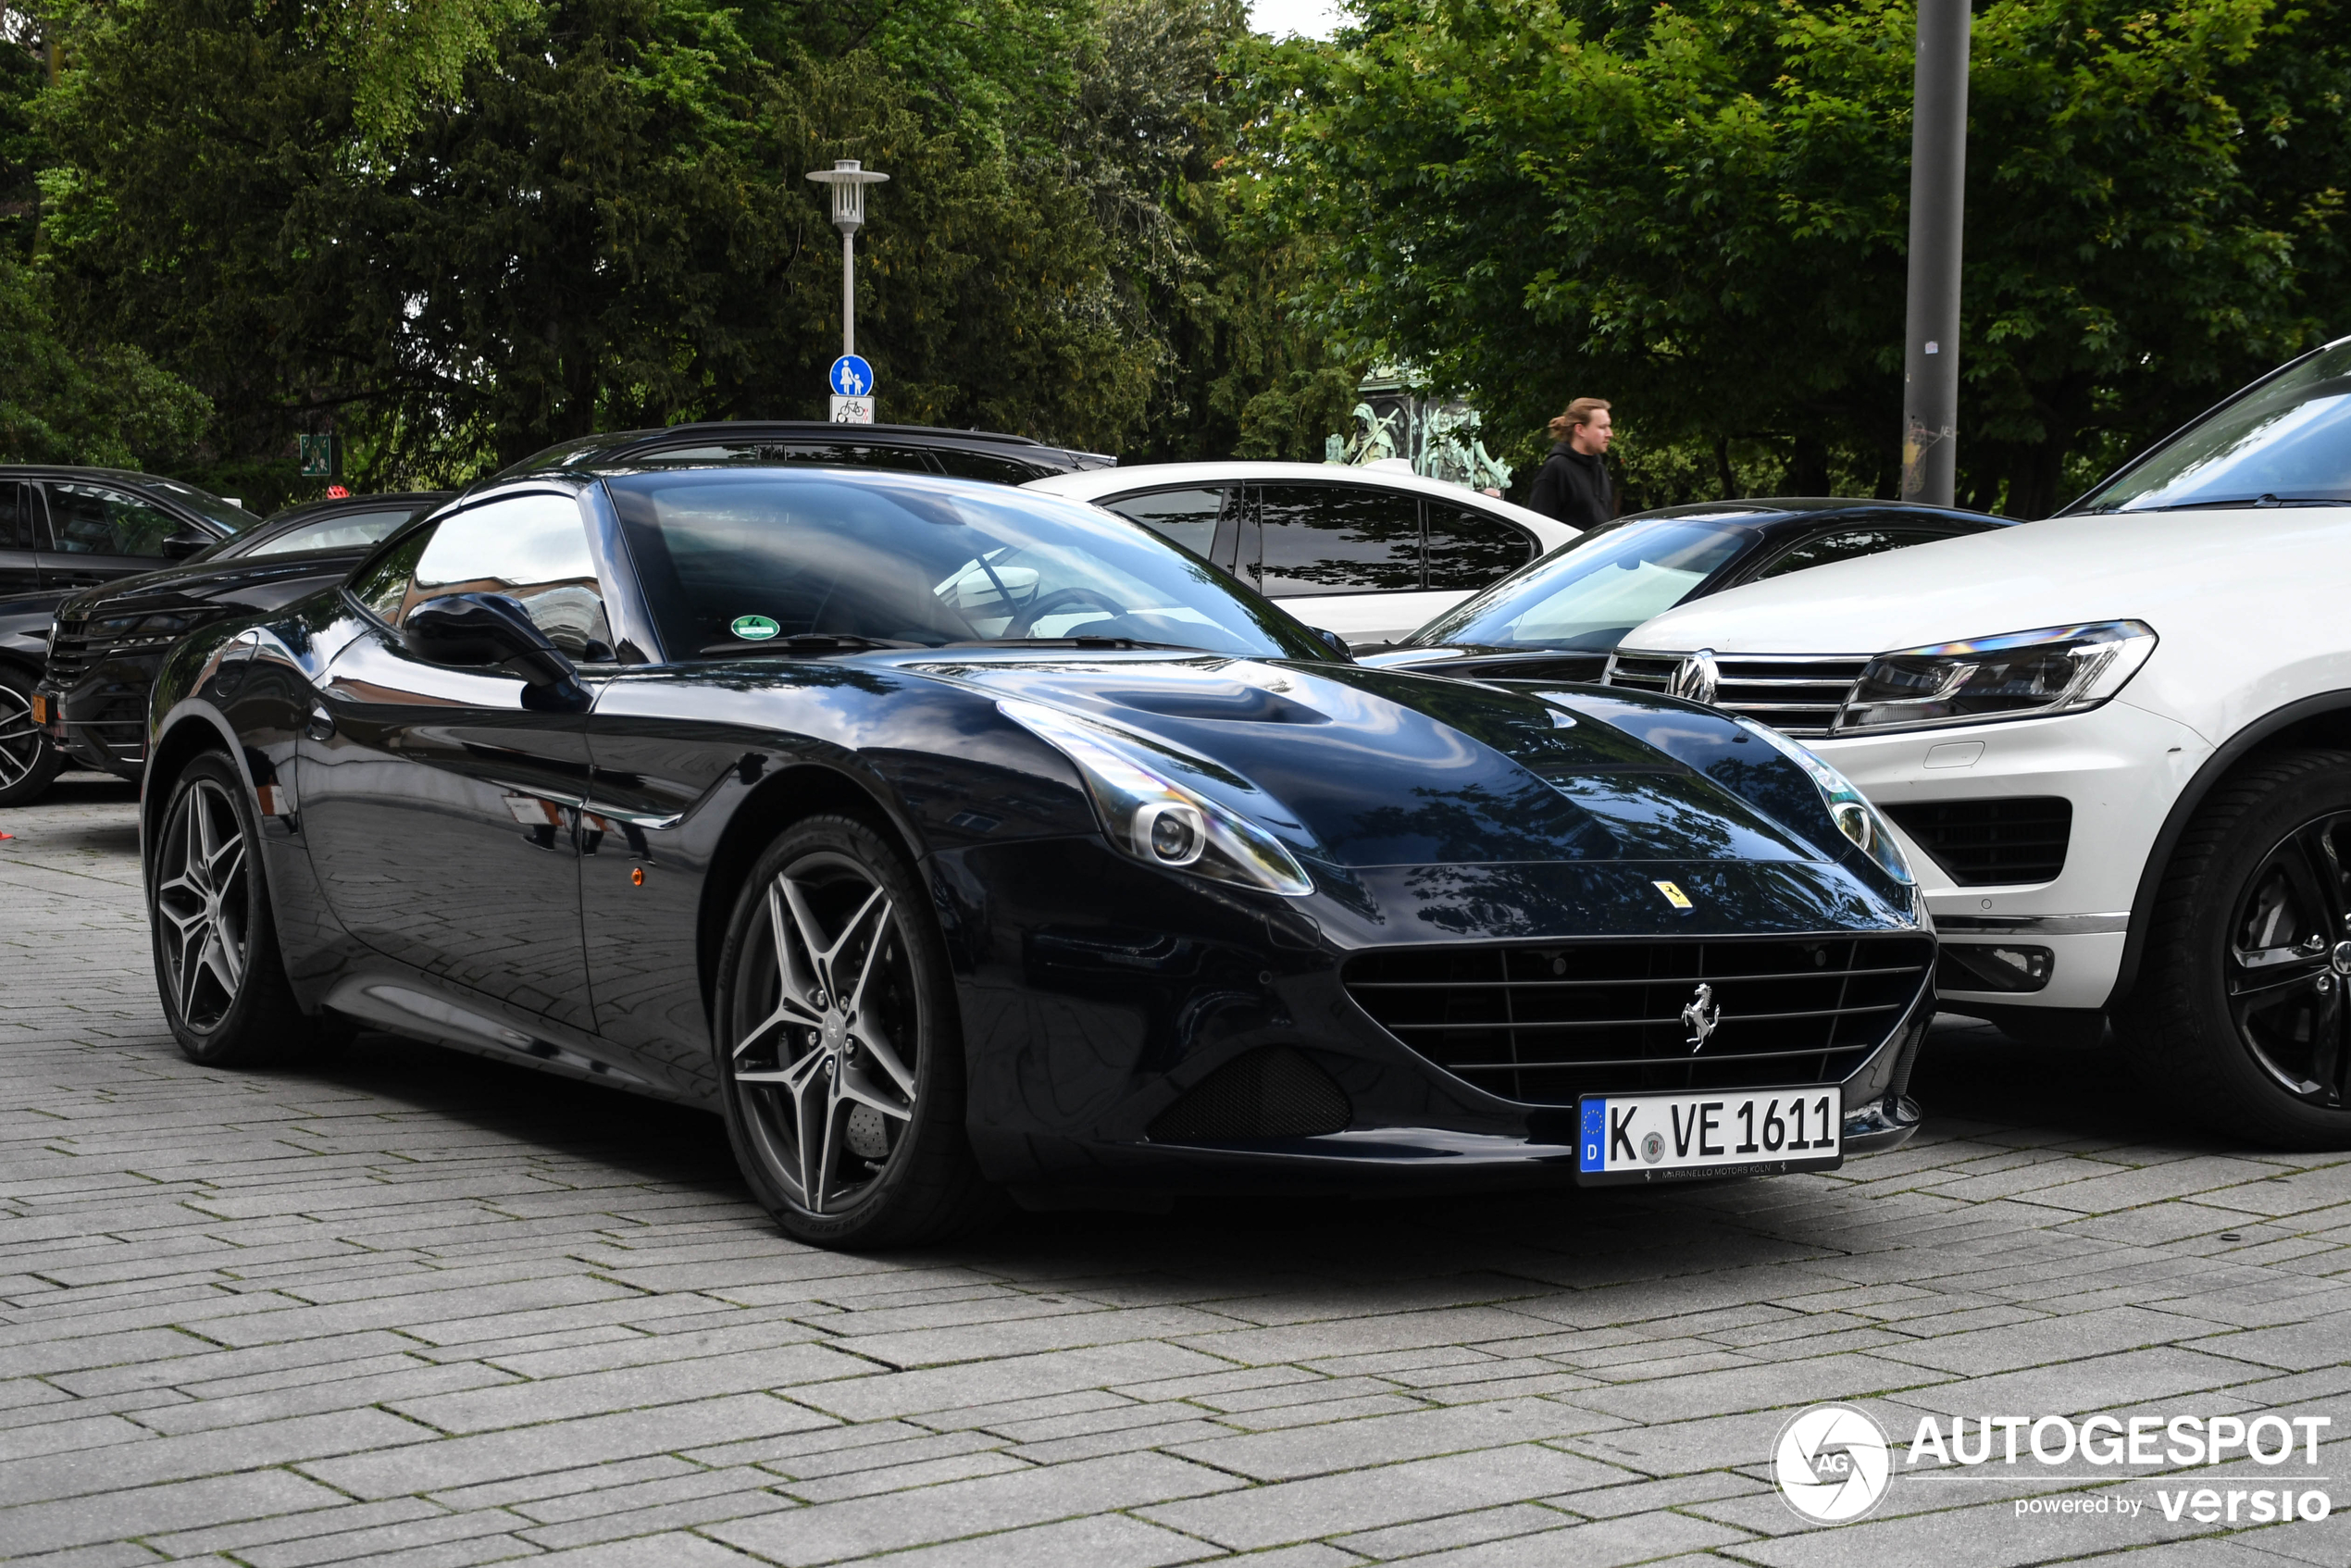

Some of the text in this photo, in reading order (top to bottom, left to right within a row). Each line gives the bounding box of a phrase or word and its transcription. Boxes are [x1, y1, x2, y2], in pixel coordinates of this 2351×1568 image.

[1611, 1106, 1637, 1161] K
[1672, 1102, 1724, 1157] VE
[1736, 1096, 1835, 1153] 1611
[1587, 1145, 1597, 1160] D
[1661, 1168, 1712, 1179] MARANELLO
[1714, 1165, 1748, 1176] MOTORS
